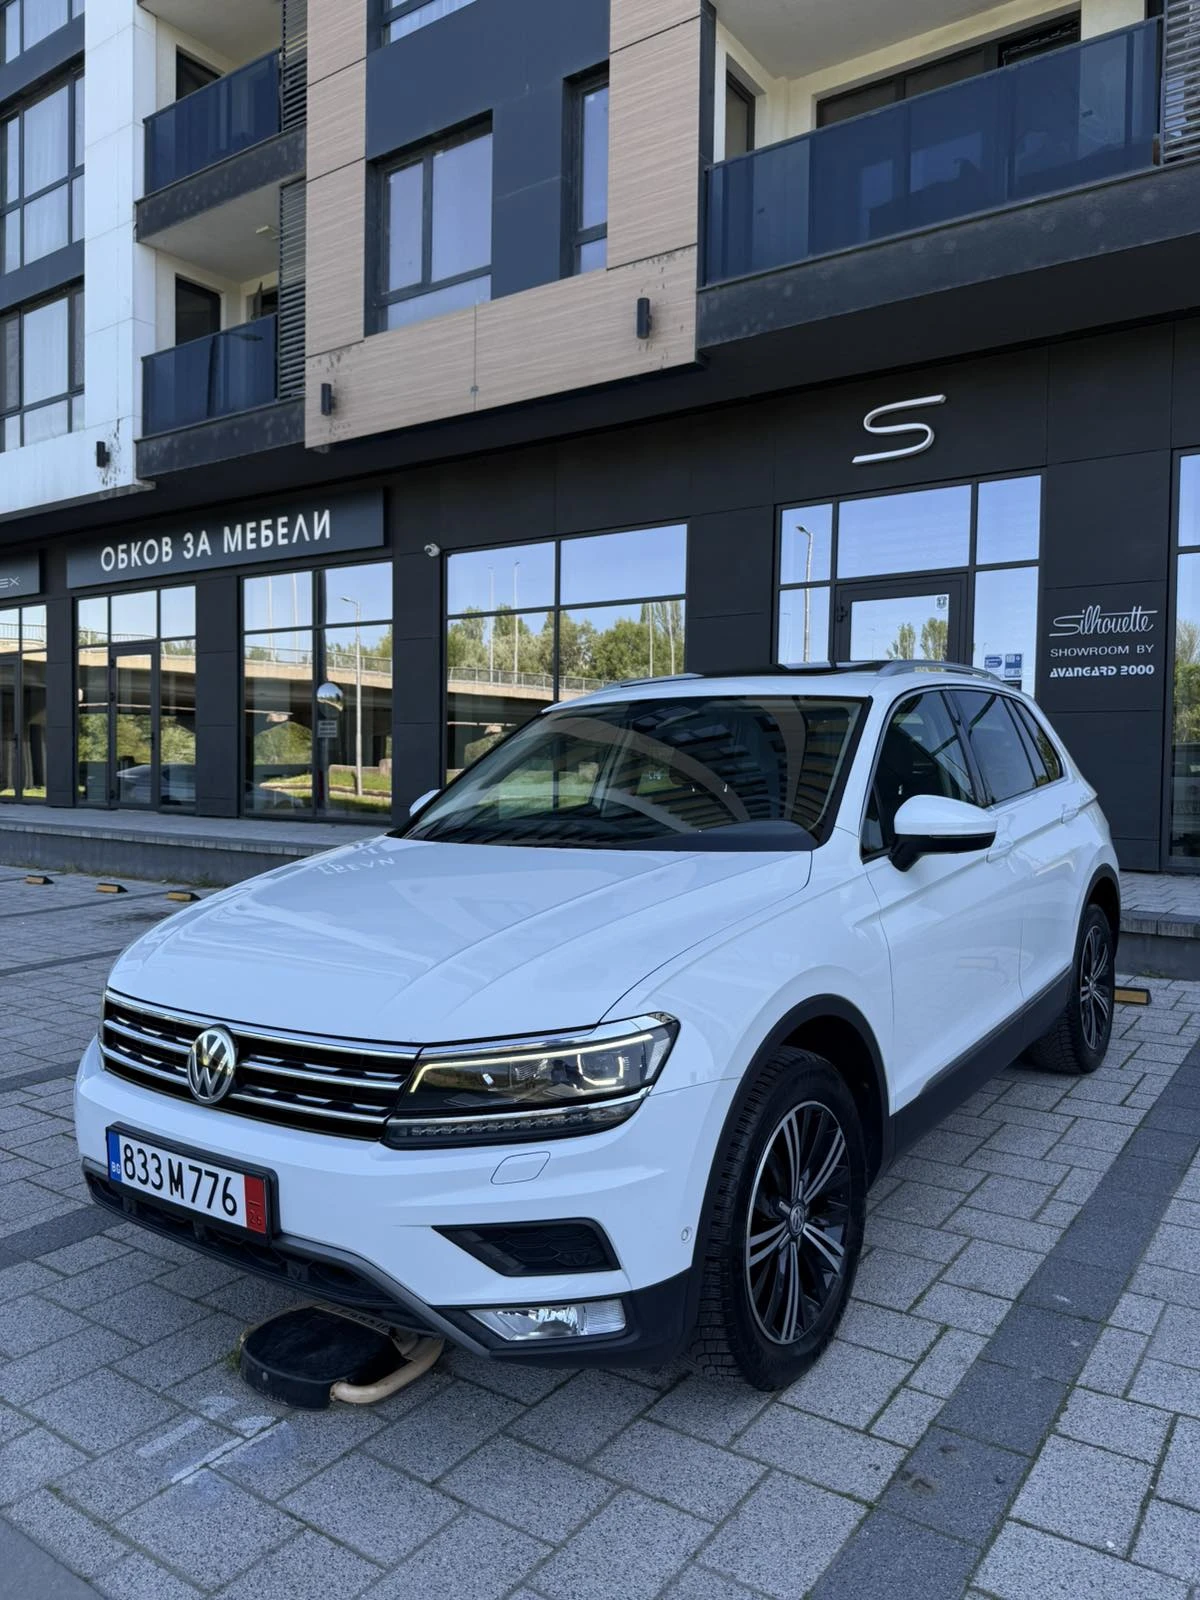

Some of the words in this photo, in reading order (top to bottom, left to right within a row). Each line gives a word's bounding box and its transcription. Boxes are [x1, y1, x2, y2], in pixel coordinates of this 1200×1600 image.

[851, 394, 946, 464] S
[101, 536, 173, 571] ОБКОВ
[183, 529, 212, 559] ЗА
[223, 509, 331, 553] МЕБЕЛИ
[1049, 605, 1158, 637] Silhouette
[1050, 645, 1129, 657] SHOWROOM
[1136, 644, 1154, 653] BY
[1049, 665, 1118, 678] AVANGARD
[1120, 664, 1155, 676] 2000
[187, 1027, 236, 1103] VW
[111, 1161, 121, 1175] BG
